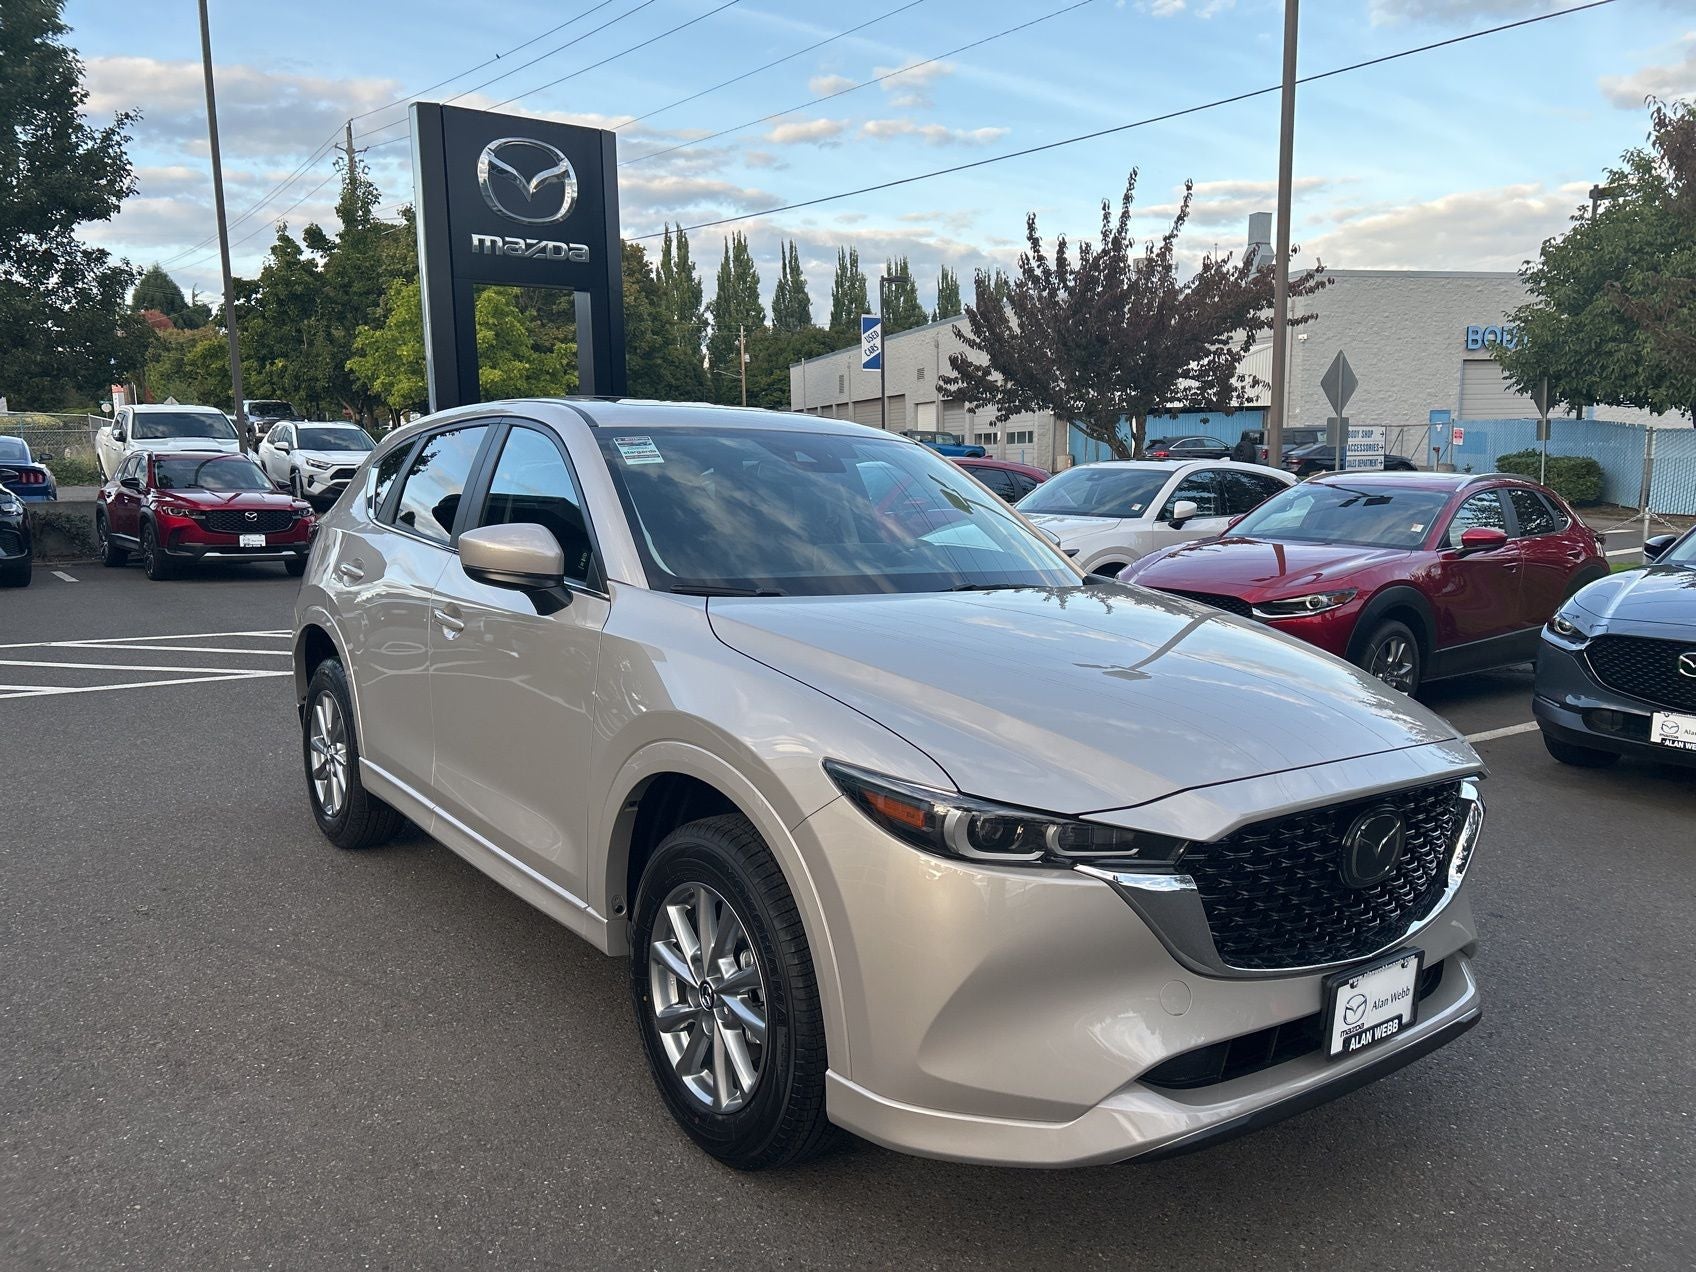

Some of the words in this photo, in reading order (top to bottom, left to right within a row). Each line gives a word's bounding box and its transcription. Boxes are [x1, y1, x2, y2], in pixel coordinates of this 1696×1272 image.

[864, 330, 879, 344] USED
[864, 343, 879, 357] CARS
[1348, 443, 1379, 452] ACCESSORIES
[1371, 998, 1389, 1012] Alan
[1391, 986, 1410, 1003] Webb
[1348, 1029, 1373, 1052] ALAN
[1374, 1018, 1399, 1040] WEBB
